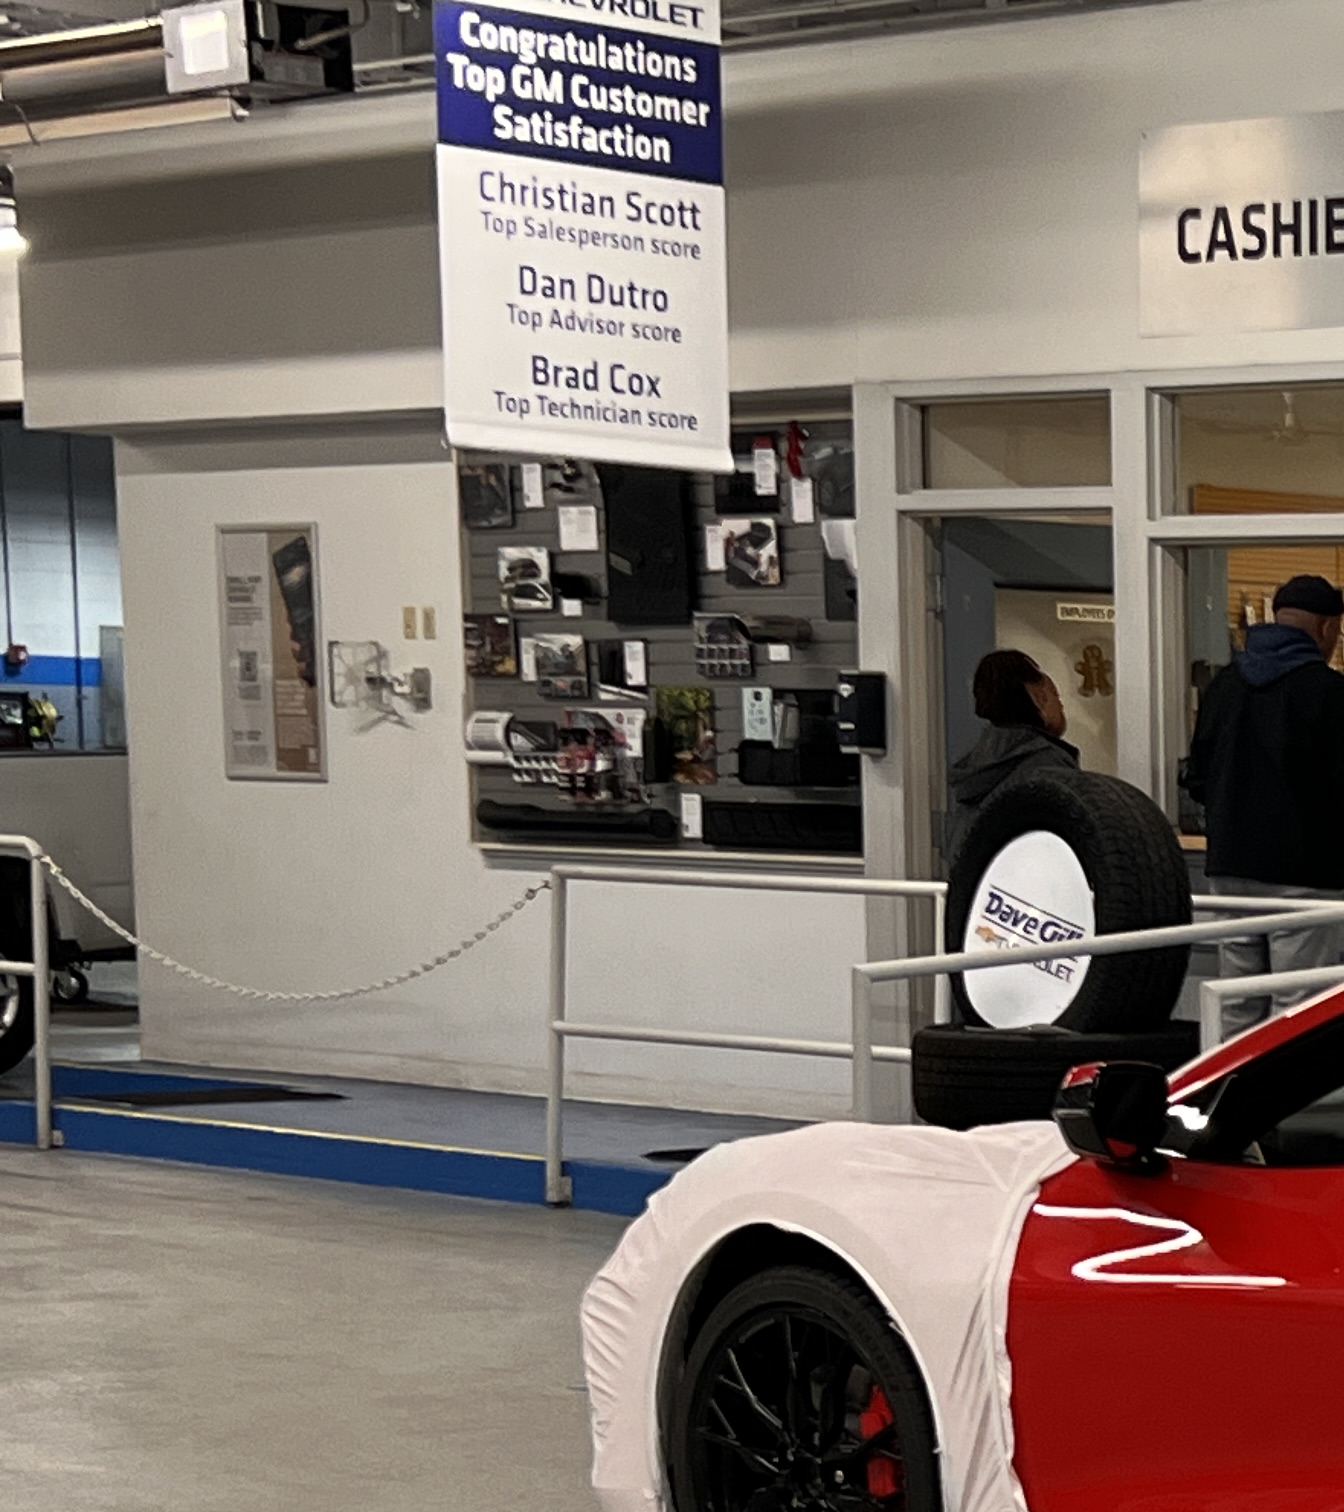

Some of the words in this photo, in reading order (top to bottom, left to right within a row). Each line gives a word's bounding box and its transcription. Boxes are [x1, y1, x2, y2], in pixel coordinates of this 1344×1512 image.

[556, 0, 704, 29] VROLET
[458, 10, 698, 83] Congratulations
[445, 52, 506, 102] Top
[511, 63, 564, 105] GM
[570, 73, 711, 127] Customer
[492, 104, 672, 163] Satisfaction
[479, 170, 616, 219] Christian
[625, 191, 702, 231] Scott
[480, 209, 517, 239] Top
[523, 215, 645, 252] Salesperson
[650, 237, 702, 260] score
[518, 264, 576, 301] Dan
[586, 272, 669, 313] Dutro
[505, 302, 543, 332] Top
[549, 308, 626, 337] Advisor
[631, 321, 683, 344] score
[530, 354, 600, 392] Brad
[609, 362, 662, 399] Cox
[493, 390, 531, 420] Top
[535, 394, 643, 426] Technician
[646, 409, 699, 431] score
[985, 891, 1039, 936] Dave
[1040, 920, 1084, 943] Gi
